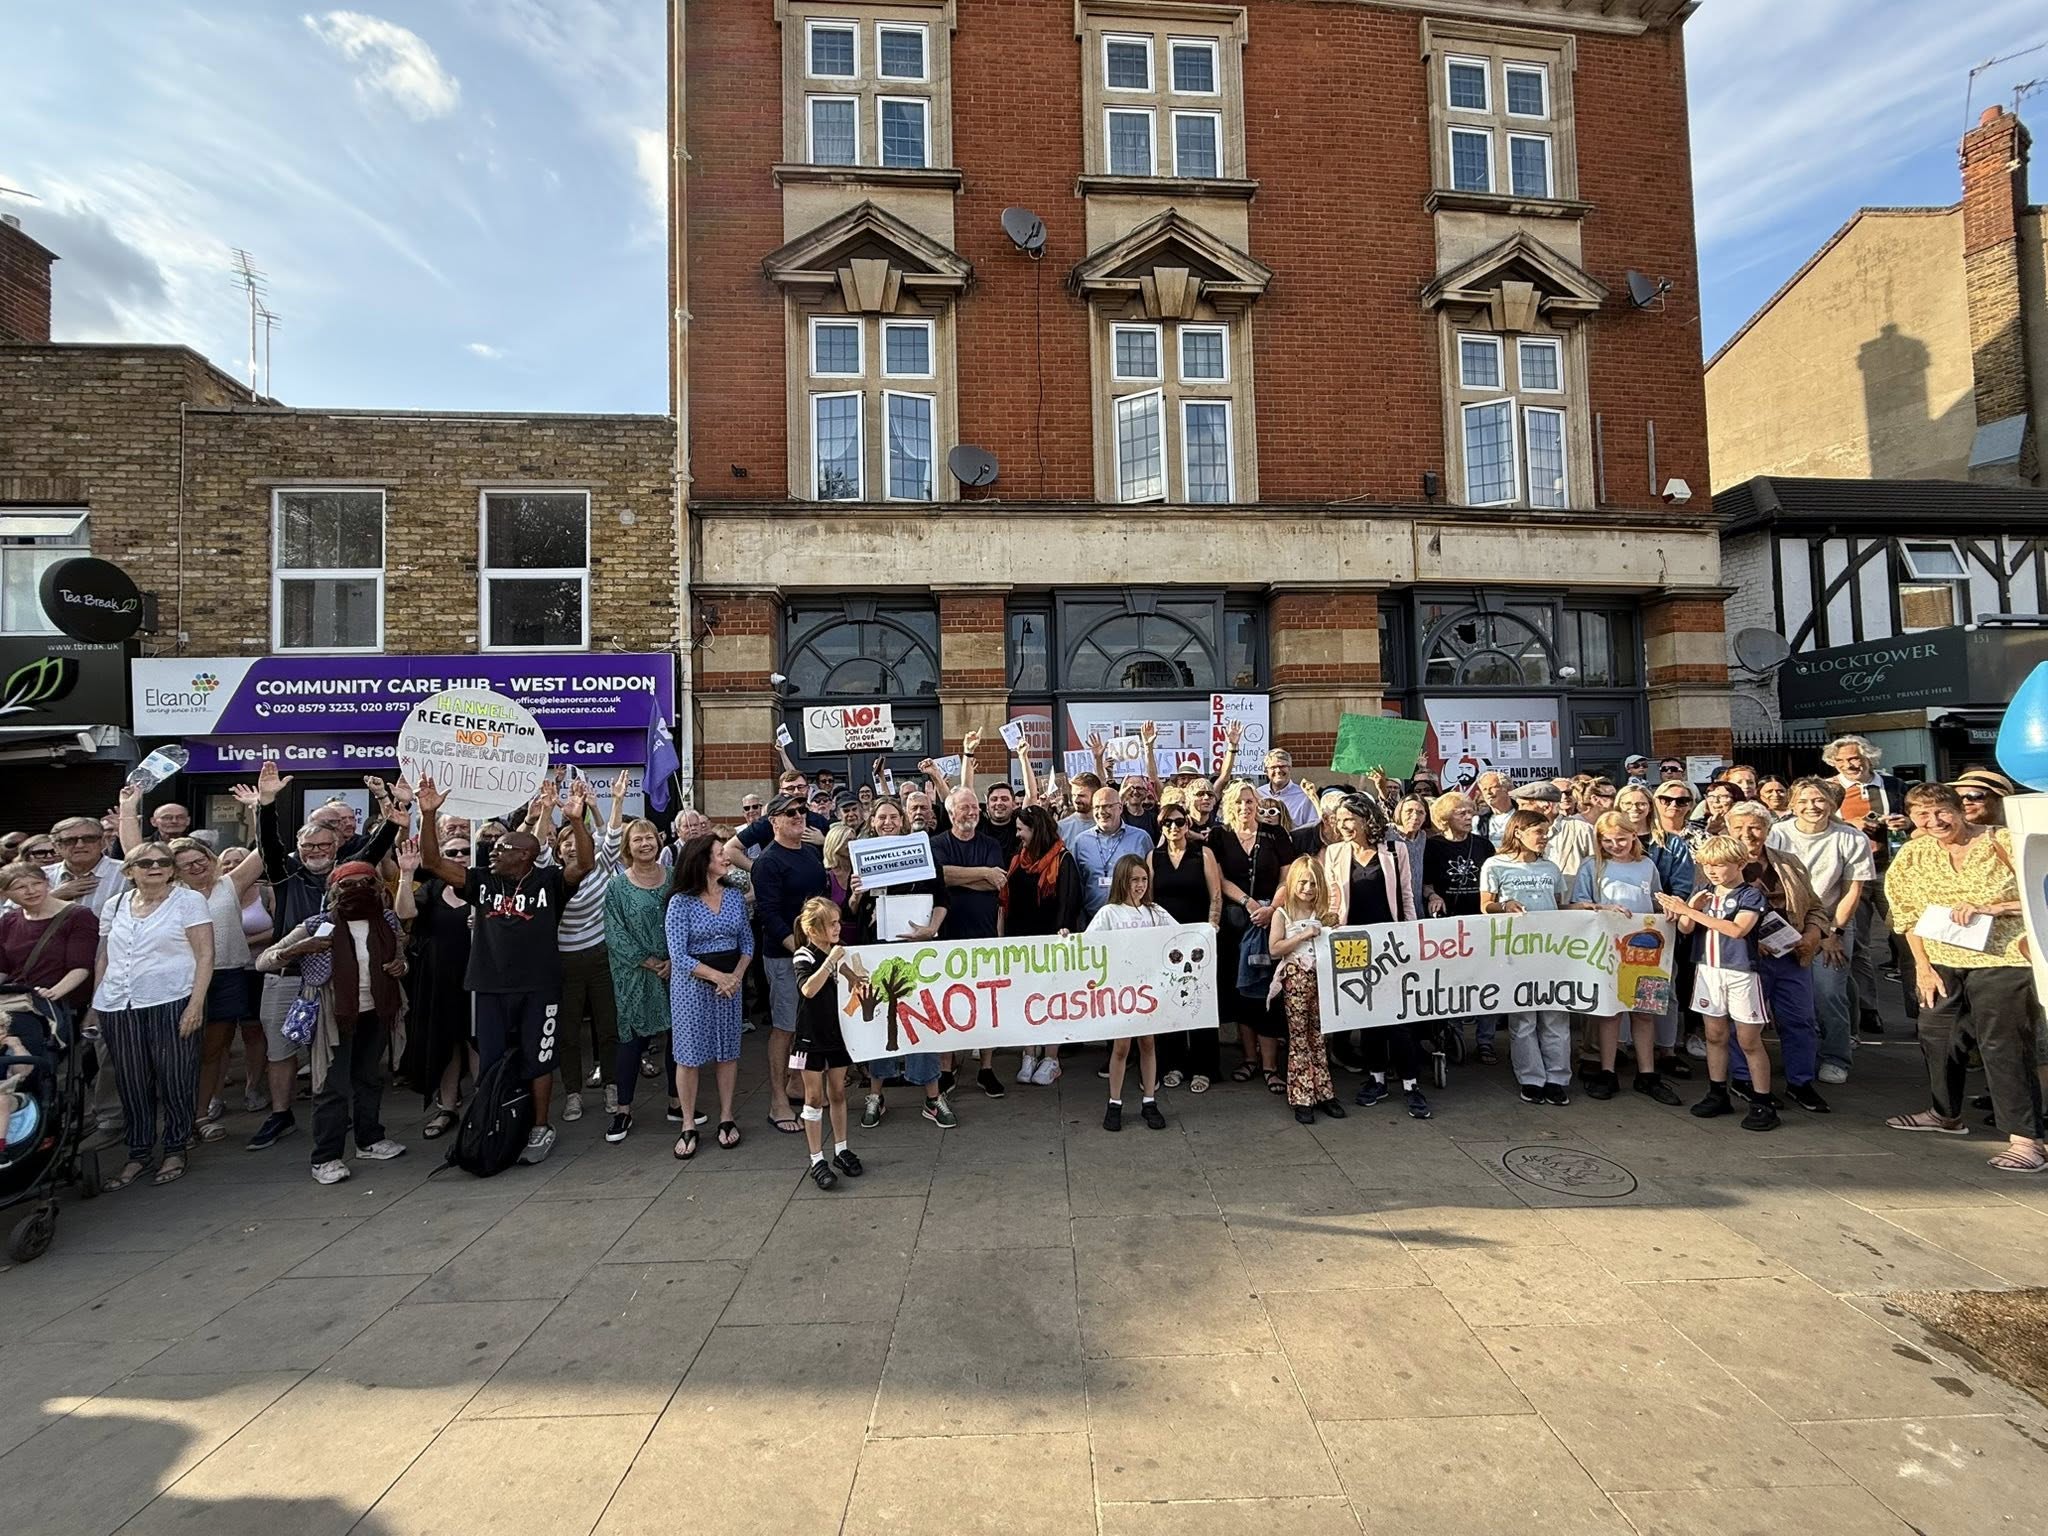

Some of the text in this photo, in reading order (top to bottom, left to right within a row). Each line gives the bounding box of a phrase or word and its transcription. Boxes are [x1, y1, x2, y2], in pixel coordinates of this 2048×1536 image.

[60, 589, 119, 609] Tea Break
[47, 643, 119, 651] www.tbreak.uk
[1796, 643, 1939, 675] CLOCKTOWER
[256, 679, 383, 695] COMMUNITY
[387, 678, 442, 693] CARE
[447, 678, 490, 690] HUB
[510, 677, 567, 691] WEST
[571, 676, 655, 691] LONDON
[1862, 694, 1891, 702] EVENTS
[1897, 688, 1929, 698] PRIVATE
[1931, 686, 1953, 695] HIRE
[146, 688, 210, 706] Eleanor
[272, 704, 294, 713] 020
[297, 703, 327, 713] 8579
[329, 702, 358, 713] 3233,
[360, 702, 383, 712] 020
[385, 702, 411, 711] 8751
[437, 696, 519, 720] HANWELL
[456, 729, 505, 748] NOT
[845, 740, 890, 749] COMMUNITY
[218, 744, 280, 760] Live-in
[285, 745, 328, 758] Care
[344, 744, 399, 758] Perso
[574, 740, 614, 754] Care
[411, 758, 537, 793] NO TO THE SLOTS
[1510, 768, 1528, 778] AND
[1531, 767, 1559, 777] PASHA
[864, 848, 922, 862] HANWELL SAYS
[900, 858, 923, 866] SLOTS
[1418, 917, 1617, 976] bet Hanwell's
[1340, 931, 1410, 1004] Don't
[1397, 969, 1500, 1021] future
[1514, 980, 1600, 1013] away
[896, 979, 1011, 1045] NOT
[1024, 980, 1158, 1026] casinos
[538, 1004, 558, 1063] BOSS
